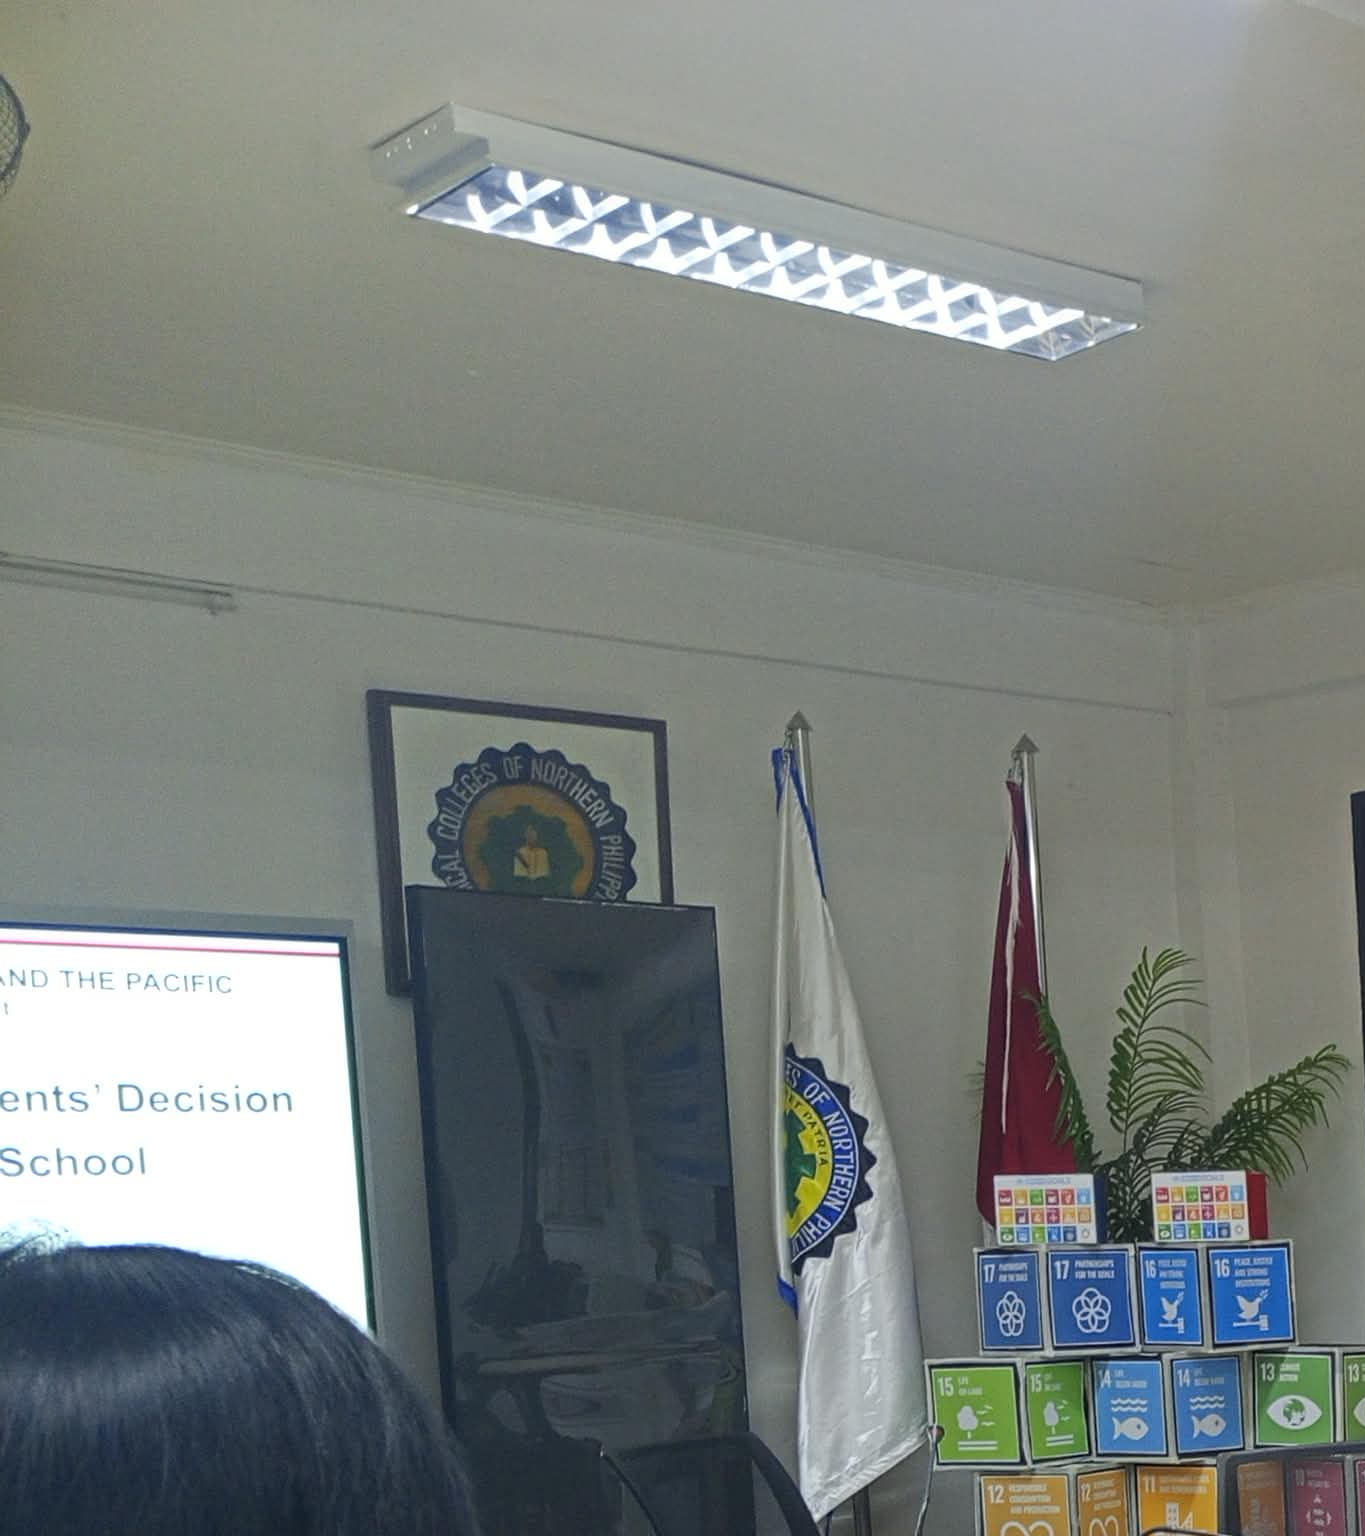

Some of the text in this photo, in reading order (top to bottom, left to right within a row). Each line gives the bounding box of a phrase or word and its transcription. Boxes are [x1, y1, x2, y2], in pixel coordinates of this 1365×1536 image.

[438, 762, 497, 841] COLLEGES
[502, 755, 525, 779] OF
[530, 758, 614, 829] NORTHERN
[59, 970, 116, 991] THE
[127, 972, 233, 994] PACIFIC
[117, 1083, 294, 1113] Decision
[802, 1109, 830, 1167] PATRIA
[804, 1081, 855, 1213] OF NORTHERN
[0, 1147, 146, 1177] School
[983, 1263, 996, 1283] 17
[1054, 1260, 1070, 1280] 17
[1145, 1259, 1157, 1278] 16
[1214, 1258, 1230, 1278] 16
[1177, 1368, 1190, 1387] 14
[1260, 1363, 1275, 1382] 13
[1348, 1363, 1360, 1383] 13
[938, 1376, 954, 1396] 15
[1030, 1374, 1043, 1392] 15
[988, 1484, 1004, 1504] 12
[1080, 1483, 1091, 1501] 12
